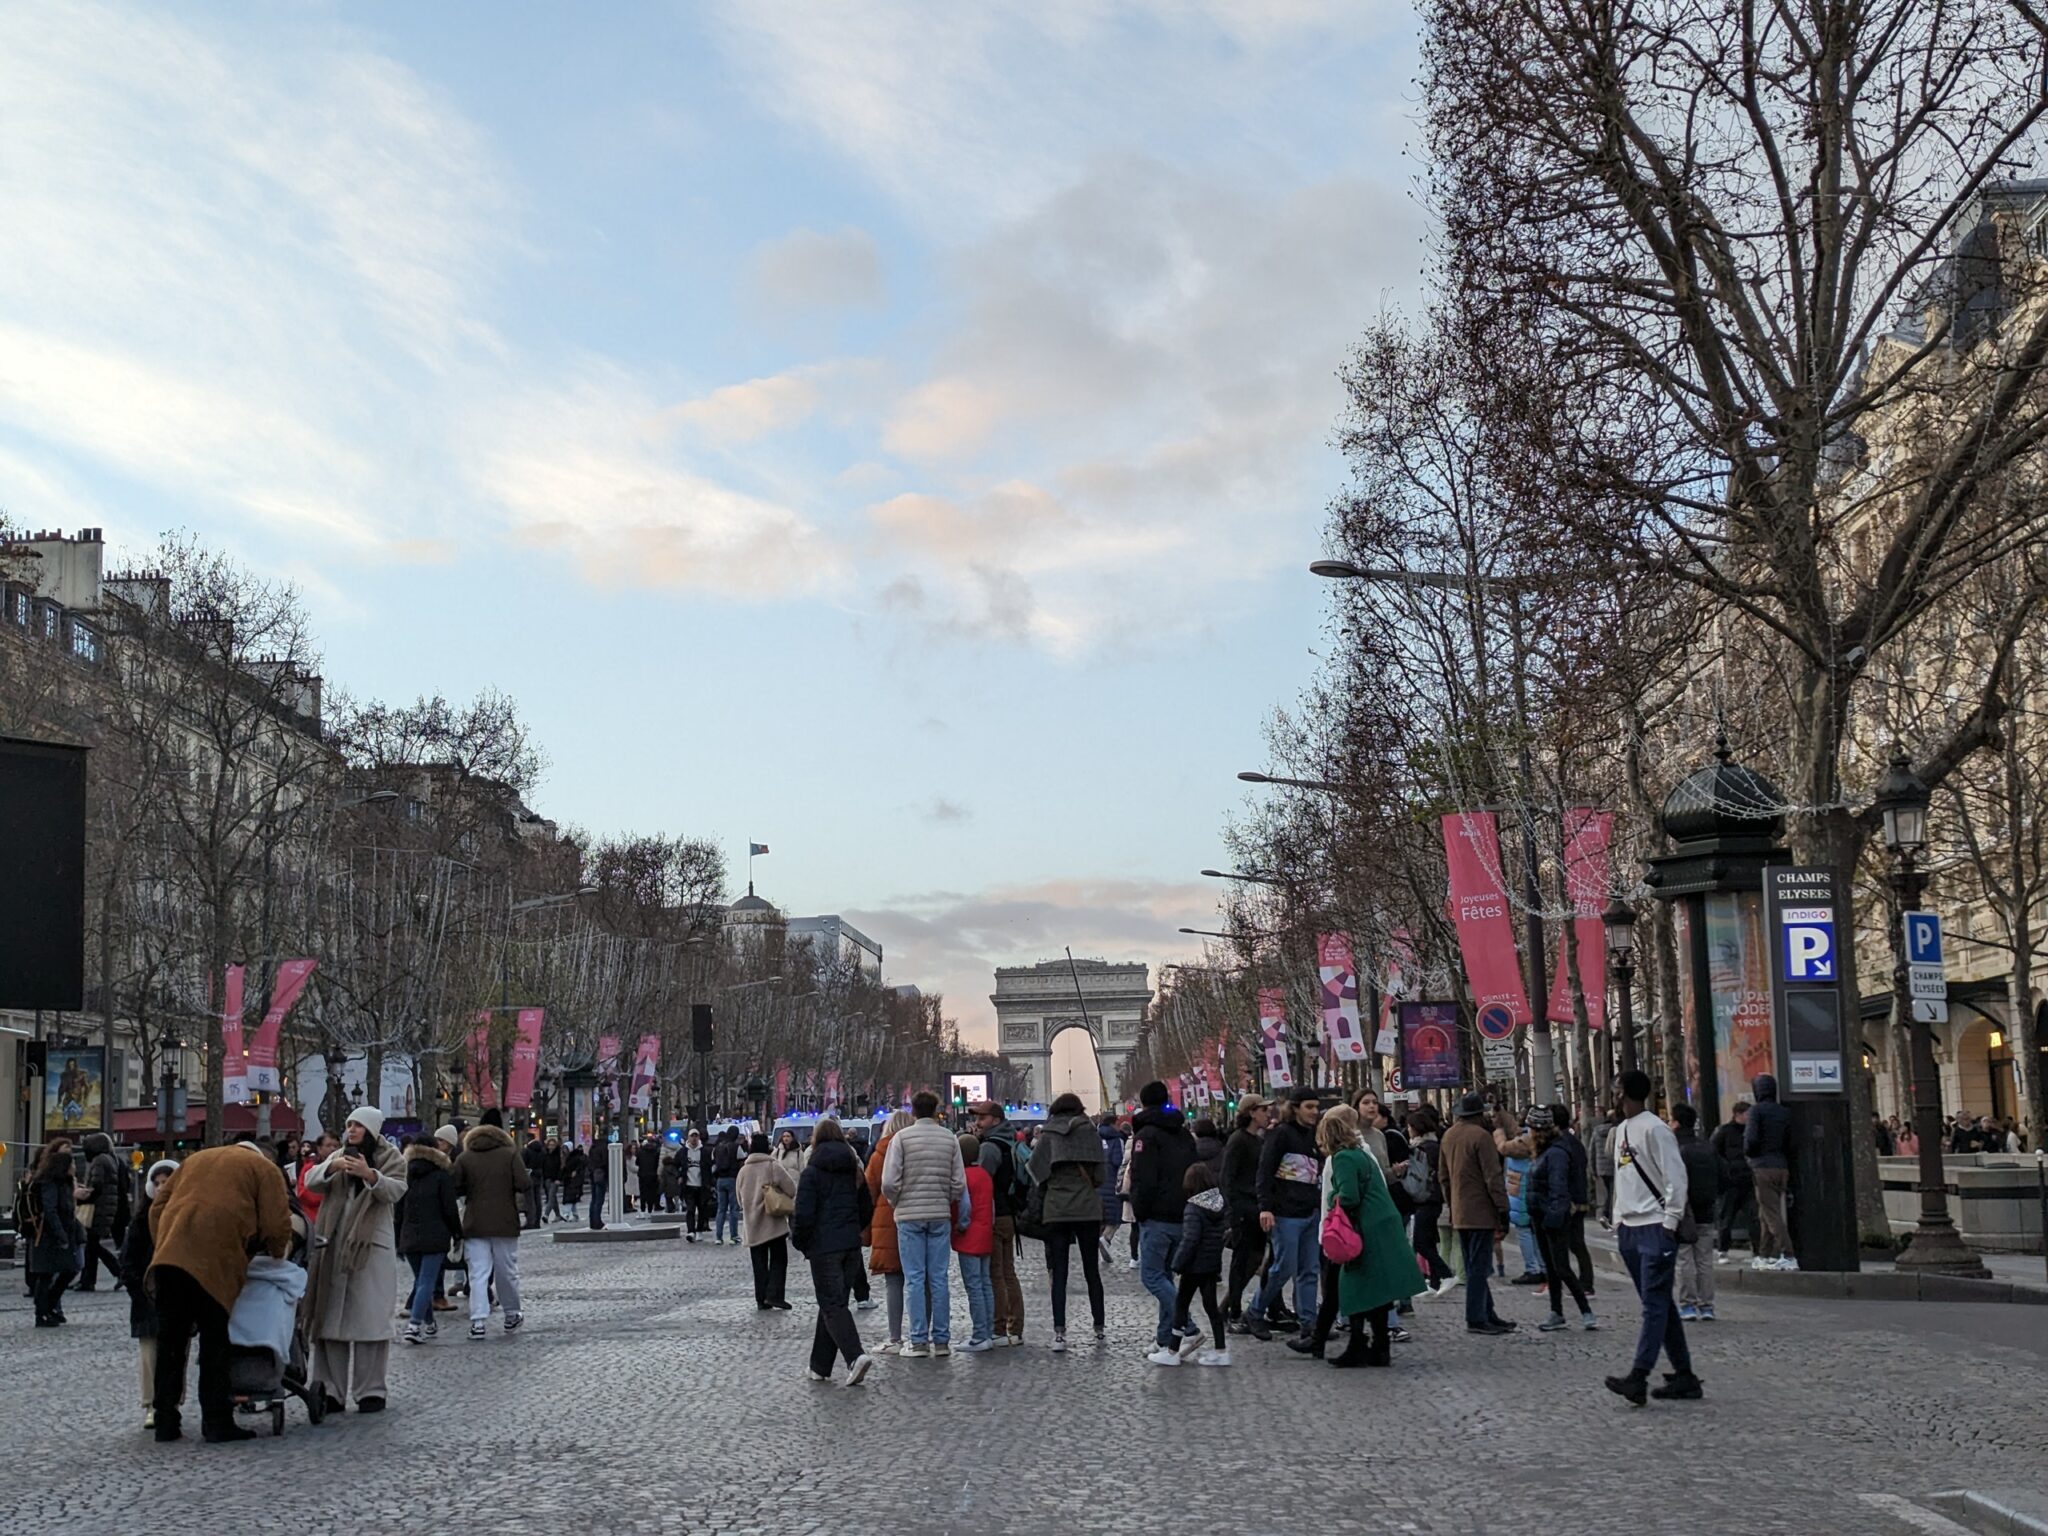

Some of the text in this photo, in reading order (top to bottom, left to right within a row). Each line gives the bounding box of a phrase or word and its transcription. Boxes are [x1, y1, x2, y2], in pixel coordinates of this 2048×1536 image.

[1776, 873, 1831, 883] CHAMPS
[1460, 892, 1499, 905] Joyeuses
[1778, 889, 1832, 900] ELYSEES
[1461, 905, 1503, 921] Fêtes
[1787, 911, 1828, 919] INDIGO
[1916, 922, 1933, 954] P
[1789, 927, 1830, 977] P
[1913, 972, 1943, 981] CHAMPS
